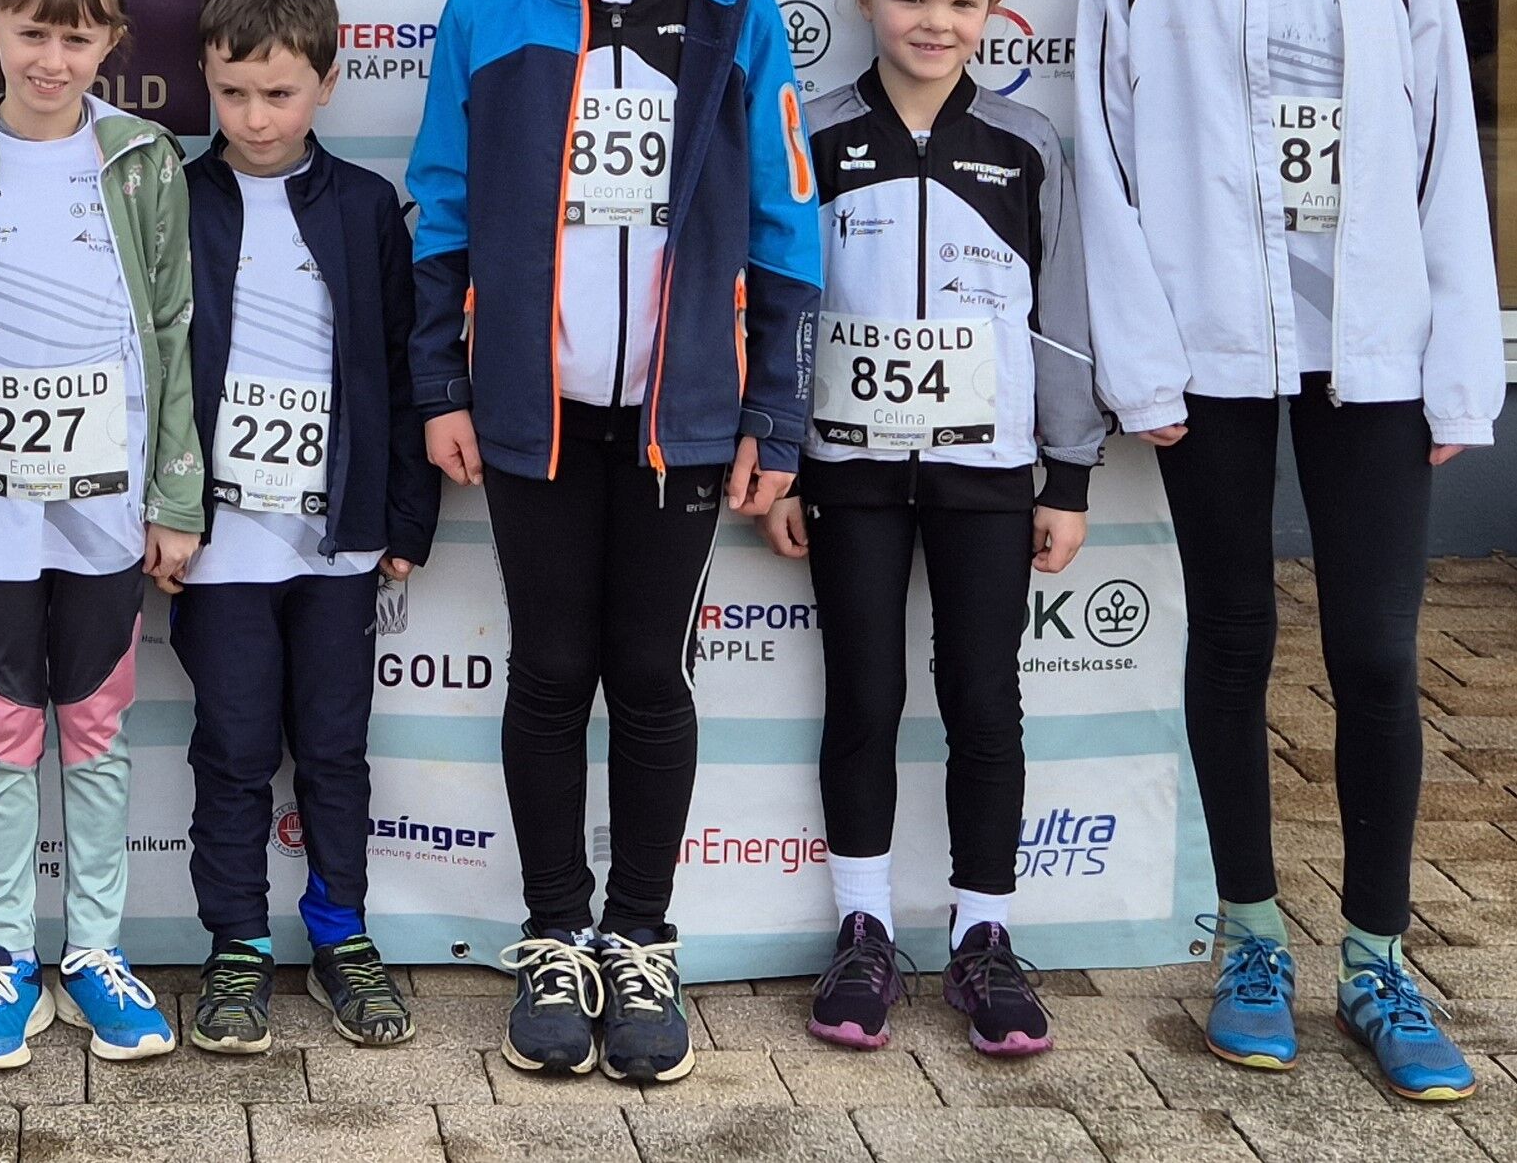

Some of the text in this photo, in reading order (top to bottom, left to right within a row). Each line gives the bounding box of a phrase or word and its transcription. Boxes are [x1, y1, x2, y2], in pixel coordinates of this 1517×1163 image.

[346, 55, 431, 80] RÄPPL
[569, 130, 667, 178] 859
[583, 184, 653, 200] Leonard
[830, 321, 974, 351] ALB·GOLD
[850, 356, 950, 404] 854
[873, 408, 926, 426] Celina
[228, 414, 325, 468] 228
[10, 458, 67, 475] Emelie
[695, 636, 775, 662] ÄPPLE
[377, 653, 493, 690] GOLD
[414, 850, 449, 864] deines
